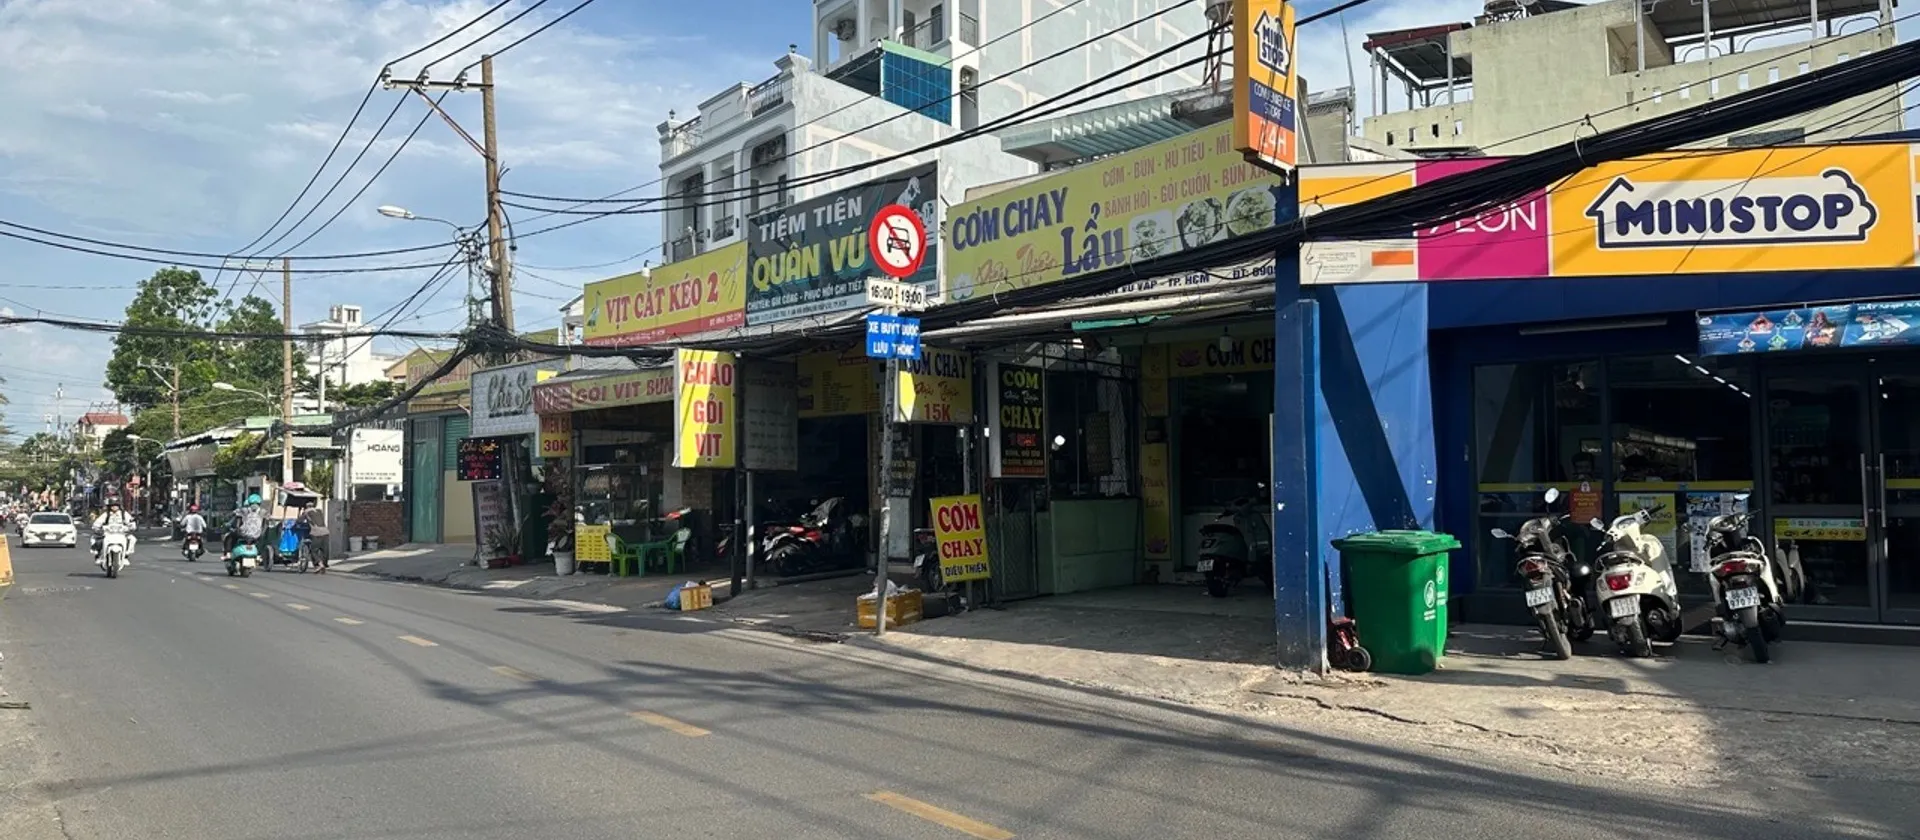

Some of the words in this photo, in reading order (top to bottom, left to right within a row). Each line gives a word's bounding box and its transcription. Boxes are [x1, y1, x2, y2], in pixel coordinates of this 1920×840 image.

[1262, 25, 1284, 52] MINI
[1262, 42, 1286, 67] STOP
[759, 212, 807, 243] TIỆM
[813, 196, 863, 228] TIỆN
[952, 206, 1001, 252] CƠM
[1004, 187, 1069, 238] CHAY
[1615, 194, 1855, 236] MINISTOP
[1061, 202, 1126, 276] Lẩu
[752, 241, 820, 292] QUÂN
[829, 228, 866, 272] VŨ
[1185, 274, 1210, 286] HCM
[606, 295, 631, 330] VỊT
[669, 273, 703, 312] KÉO
[707, 271, 719, 304] 2
[871, 285, 894, 300] 16:00
[901, 290, 922, 304] 19:00
[868, 321, 879, 334] XE
[935, 353, 968, 380] CHAY
[1002, 368, 1040, 390] CƠM
[924, 402, 951, 421] 15K
[1000, 404, 1042, 430] CHAY
[544, 439, 569, 452] 30K
[695, 433, 723, 462] VỊT
[938, 500, 981, 534] CƠM
[941, 538, 984, 560] CHAY
